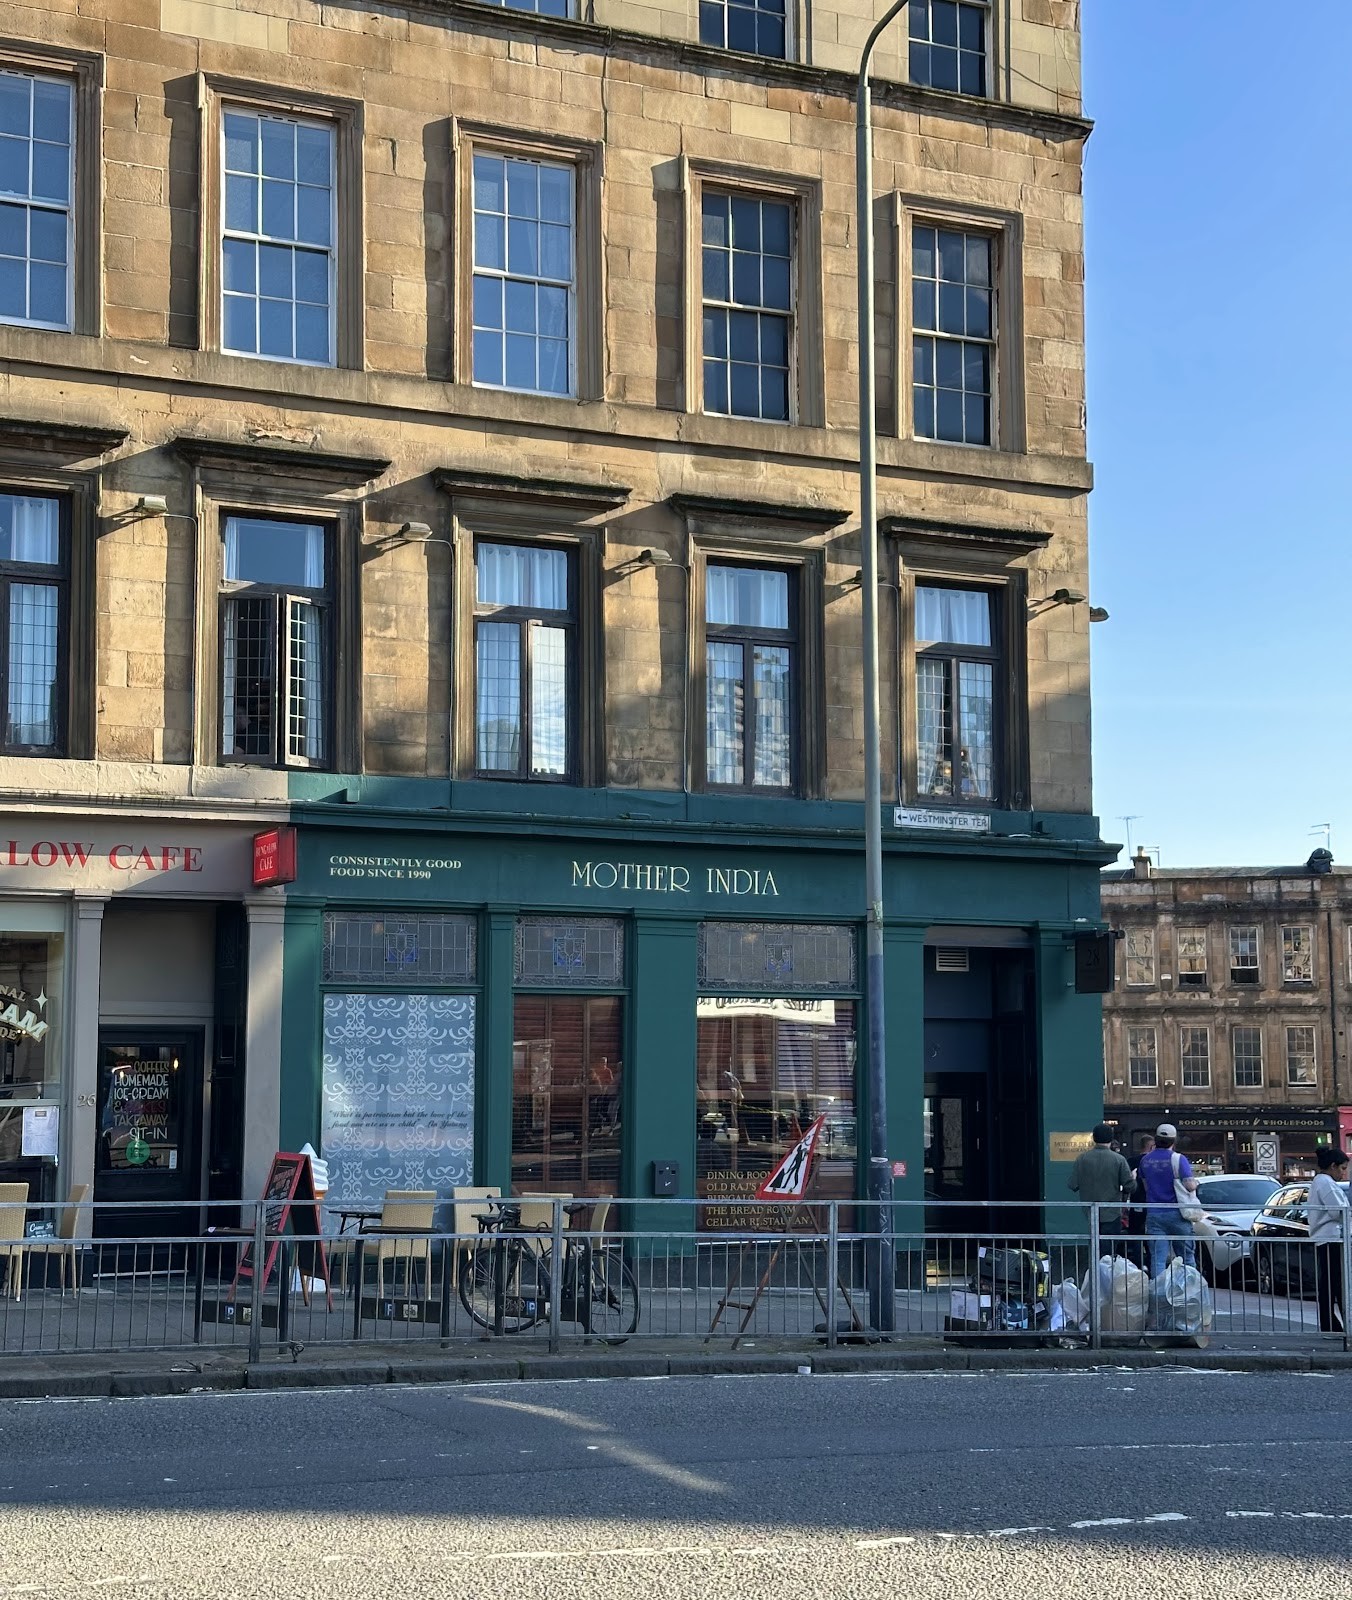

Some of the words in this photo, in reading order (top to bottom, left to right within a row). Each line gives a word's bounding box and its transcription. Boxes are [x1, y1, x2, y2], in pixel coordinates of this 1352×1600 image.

[909, 814, 968, 826] WESTMINSTER
[972, 818, 987, 827] TER
[0, 840, 94, 868] LOW
[109, 844, 203, 872] CAFE
[329, 855, 423, 868] CONSISTENTLY
[425, 858, 462, 869] GOOD
[260, 856, 273, 871] CAFE
[329, 866, 365, 877] FOOD
[367, 868, 405, 879] SINCE
[407, 870, 431, 880] 1990
[571, 860, 691, 893] MOTHER
[706, 868, 780, 896] INDIA
[0, 1003, 50, 1043] AM
[134, 1060, 170, 1073] COFFEES
[114, 1073, 170, 1086] HOMEMADE
[114, 1087, 169, 1100] ICE-CREAM
[77, 1094, 96, 1107] 26
[113, 1113, 169, 1127] TAKEAWAY
[130, 1127, 168, 1140] SIT-IN
[706, 1171, 744, 1180] DINING
[706, 1182, 728, 1191] OLD
[730, 1182, 757, 1191] RAJ'S
[707, 1193, 759, 1201] BUNGALO
[706, 1206, 728, 1215] THE
[730, 1206, 764, 1215] BREAD
[706, 1217, 746, 1227] CELLAR
[749, 1216, 813, 1226] RESTAUAN
